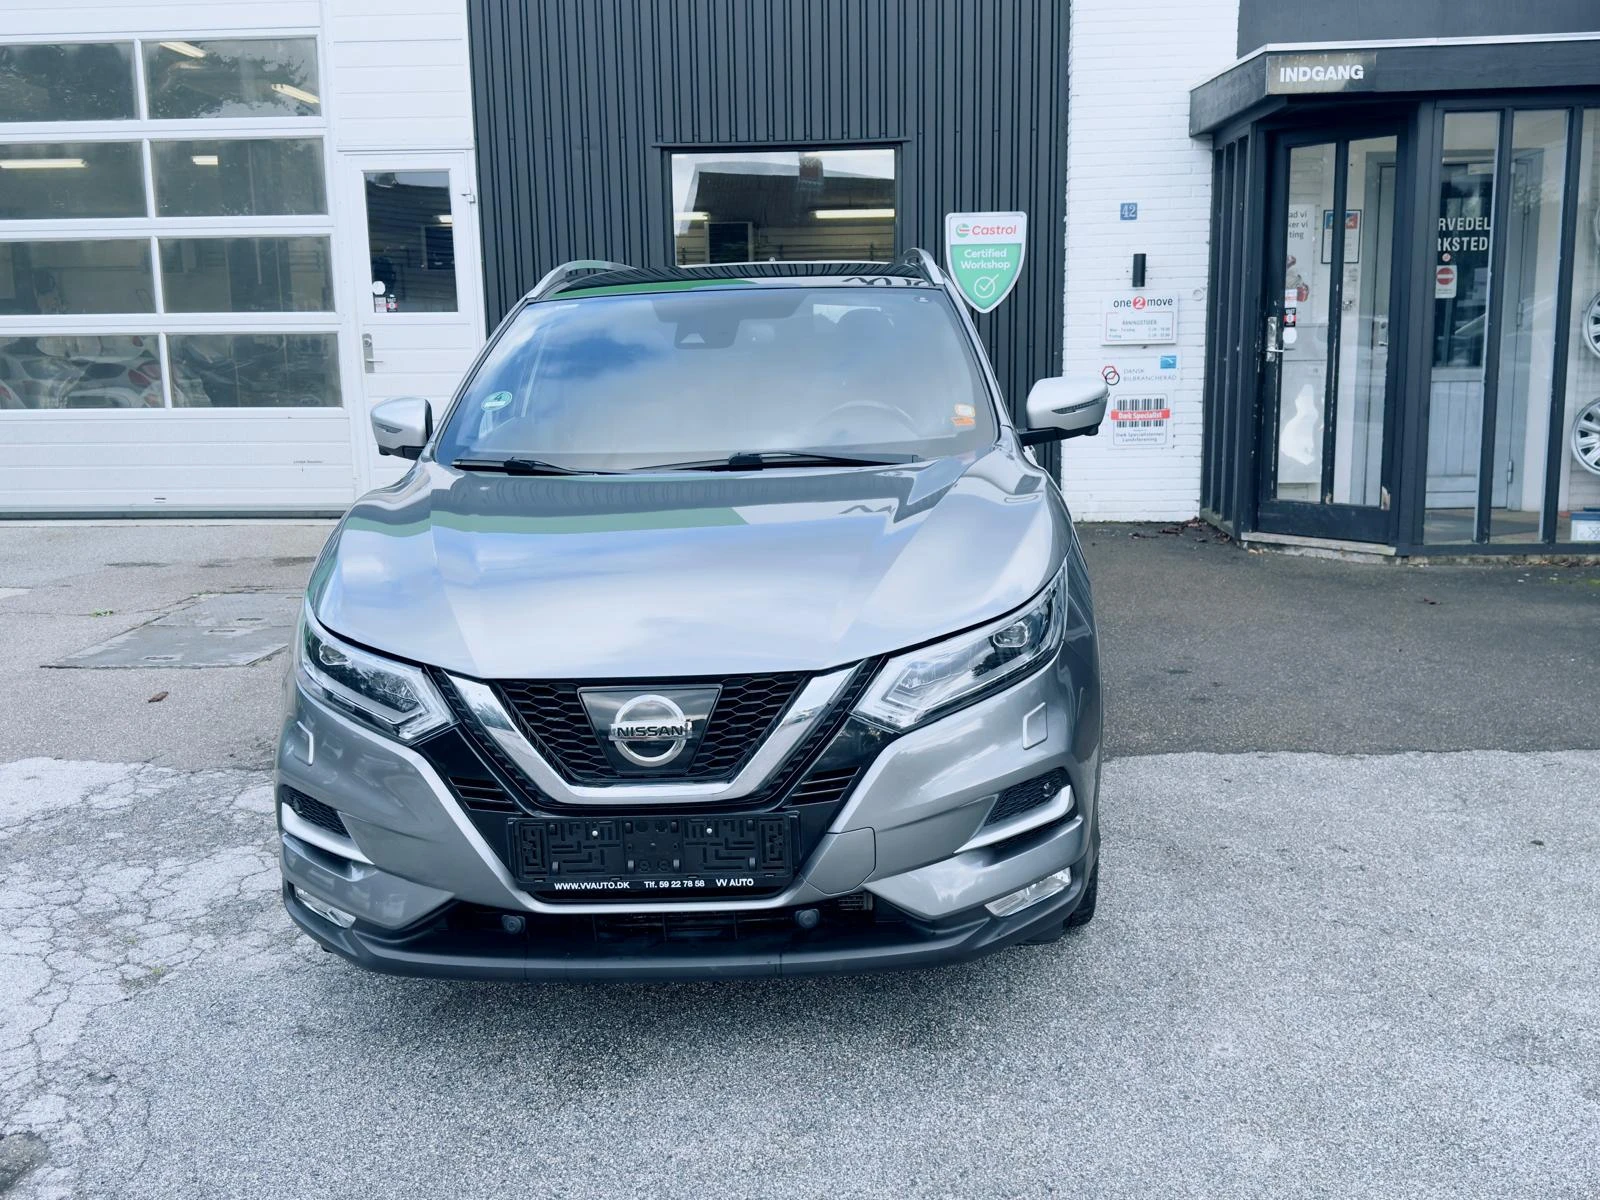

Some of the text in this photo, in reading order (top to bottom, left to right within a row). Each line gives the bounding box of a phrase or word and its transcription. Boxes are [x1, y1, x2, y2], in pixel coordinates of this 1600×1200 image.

[1279, 64, 1364, 83] INDGANG
[1122, 204, 1137, 218] 42
[971, 225, 1017, 236] Castrol
[964, 248, 1008, 258] Certified
[960, 260, 1011, 271] Workshop
[616, 725, 684, 738] NISSAN
[554, 881, 630, 891] WWW.VVAUTO.DK
[658, 880, 669, 888] 59
[670, 880, 682, 888] 22
[683, 880, 694, 888] 78
[694, 879, 705, 887] 58
[728, 878, 755, 887] AUTO
